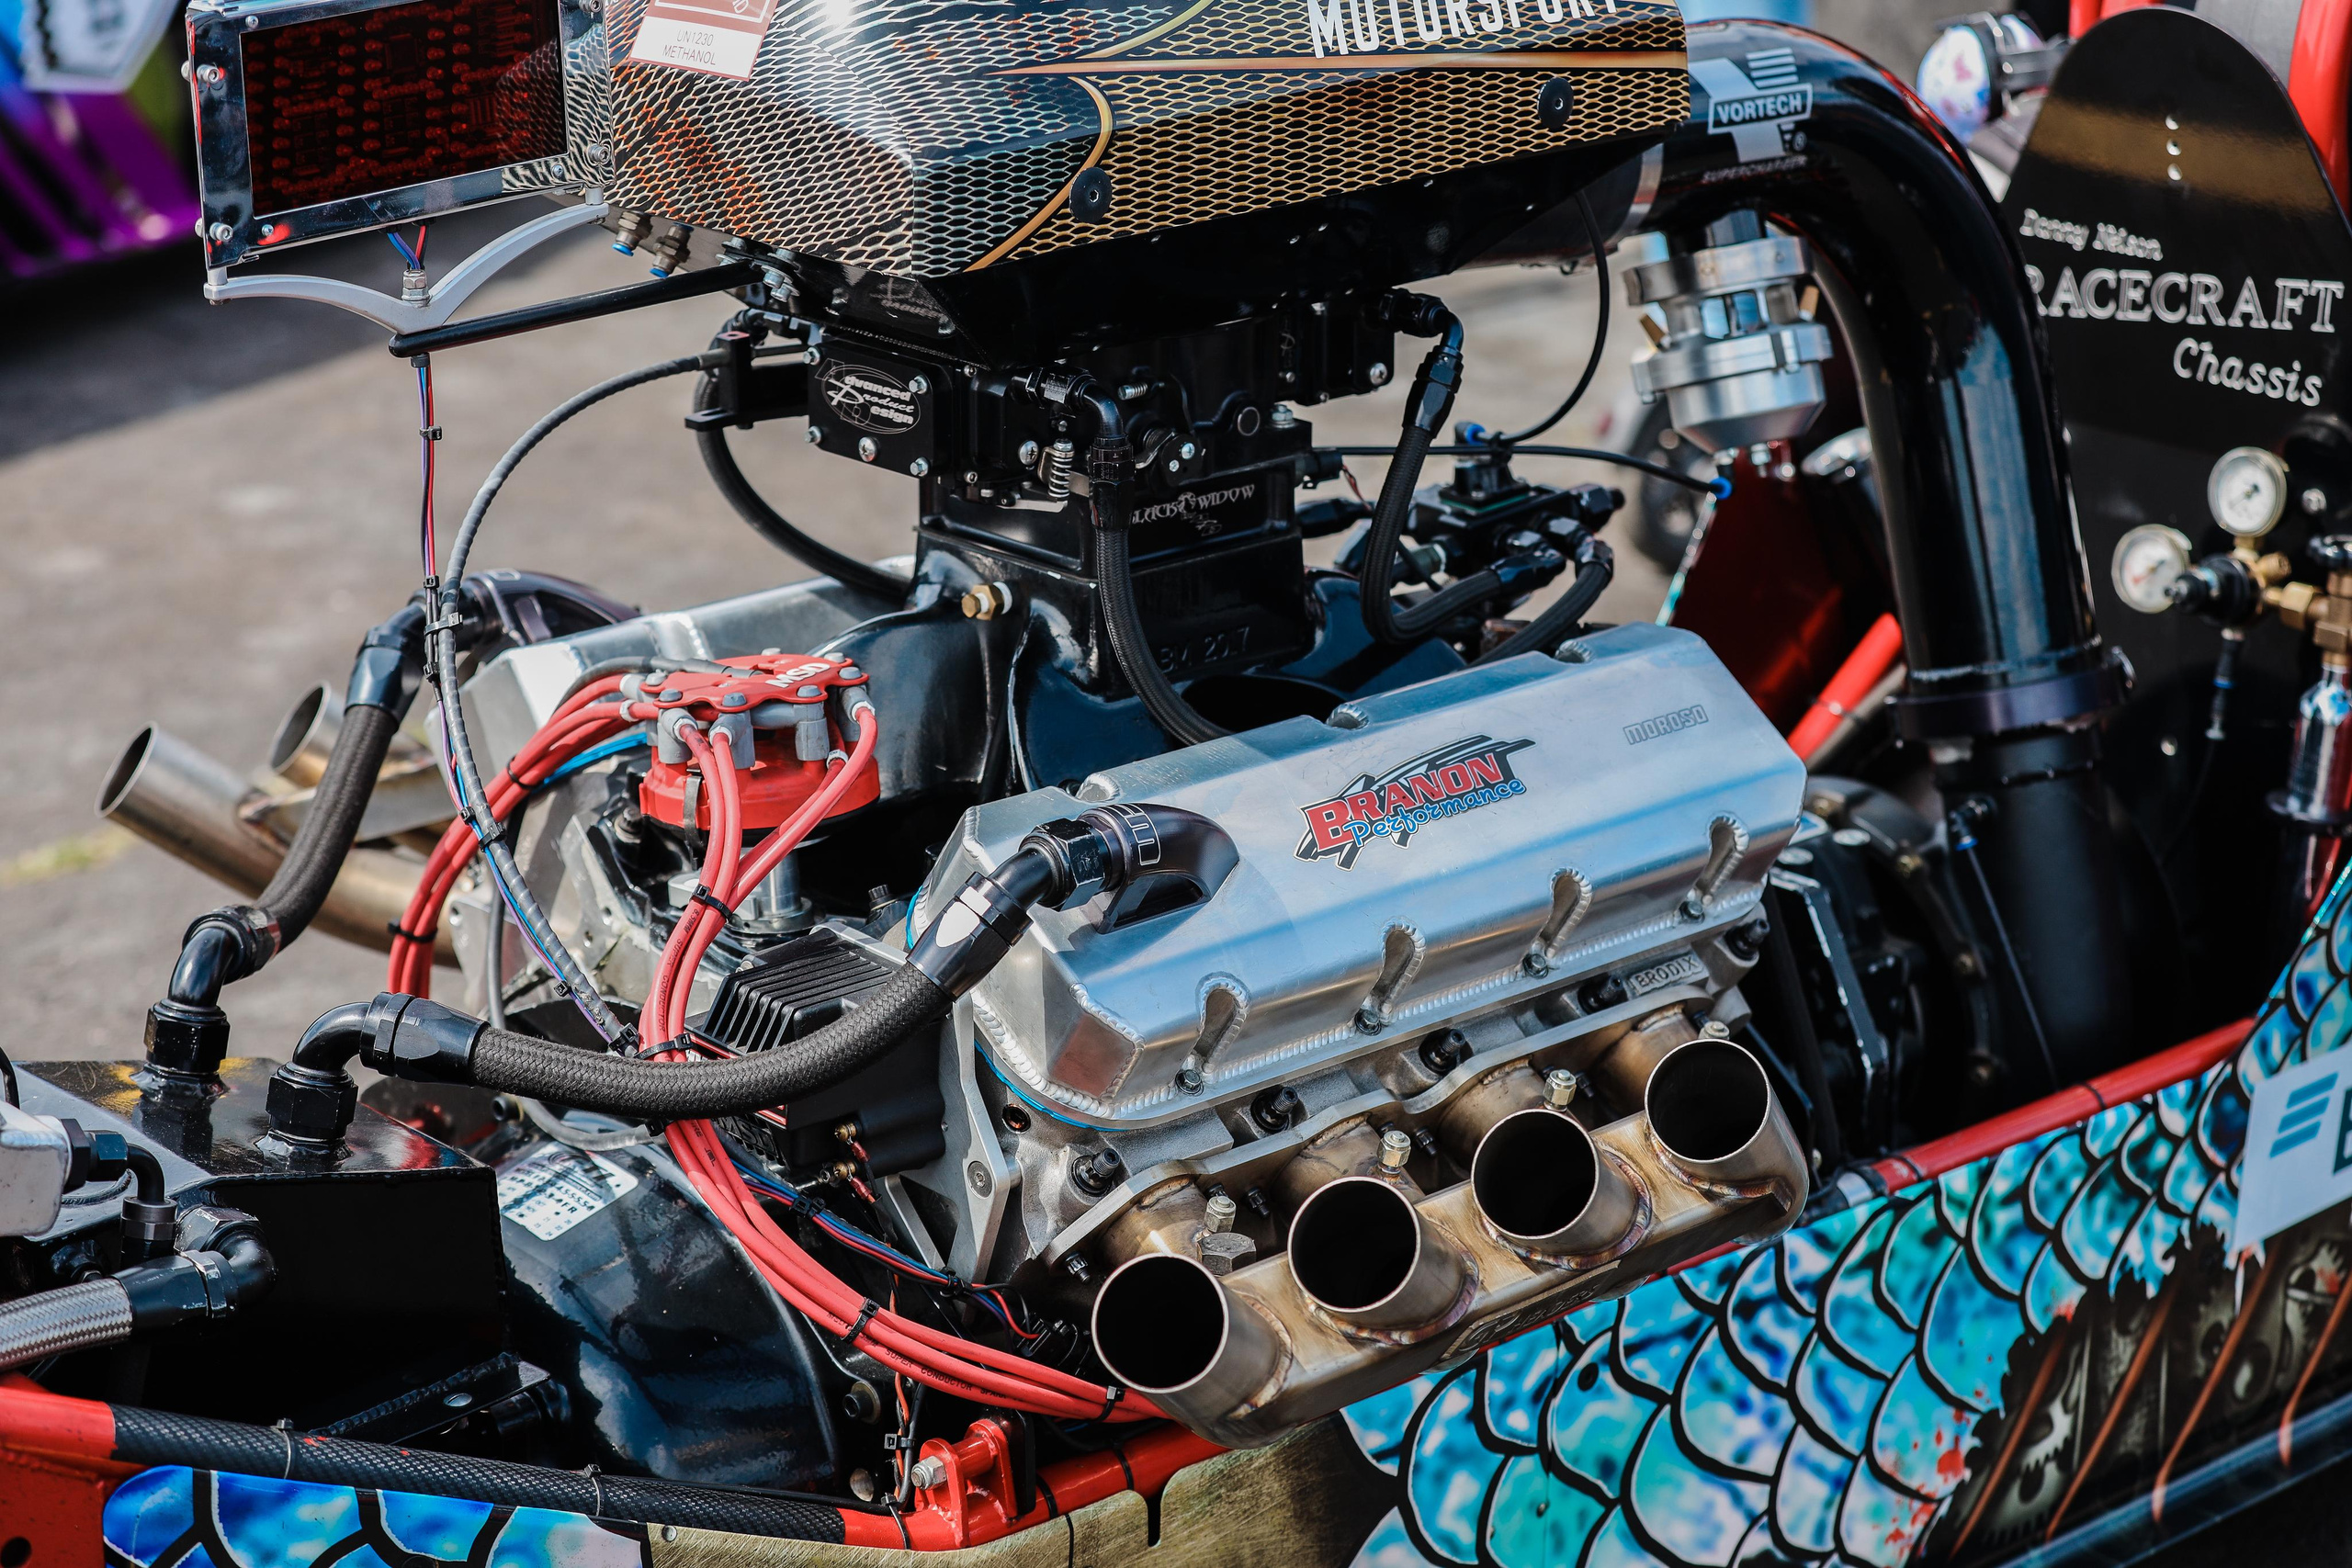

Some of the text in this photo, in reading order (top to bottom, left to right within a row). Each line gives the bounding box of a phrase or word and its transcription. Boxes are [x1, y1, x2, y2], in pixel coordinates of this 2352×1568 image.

[676, 28, 714, 47] UN1230
[1306, 0, 1617, 59] MOTORSP
[662, 44, 716, 66] METHANOL
[1715, 92, 1804, 125] VORTECH
[2024, 264, 2346, 333] RACECRAFT
[2173, 337, 2324, 407] Chassis
[826, 378, 915, 413] Product
[1132, 502, 1180, 525] LACK
[1197, 484, 1255, 510] WIDOW
[764, 662, 831, 689] MSD
[1622, 704, 1710, 746] MOROSO
[1305, 751, 1505, 852] BRANON
[1342, 778, 1527, 848] Performance
[1635, 954, 1700, 988] BRODIX
[658, 975, 671, 1033] CONDUCTOR
[885, 1348, 913, 1369] SUPER
[921, 1366, 974, 1392] CONDUCTOR
